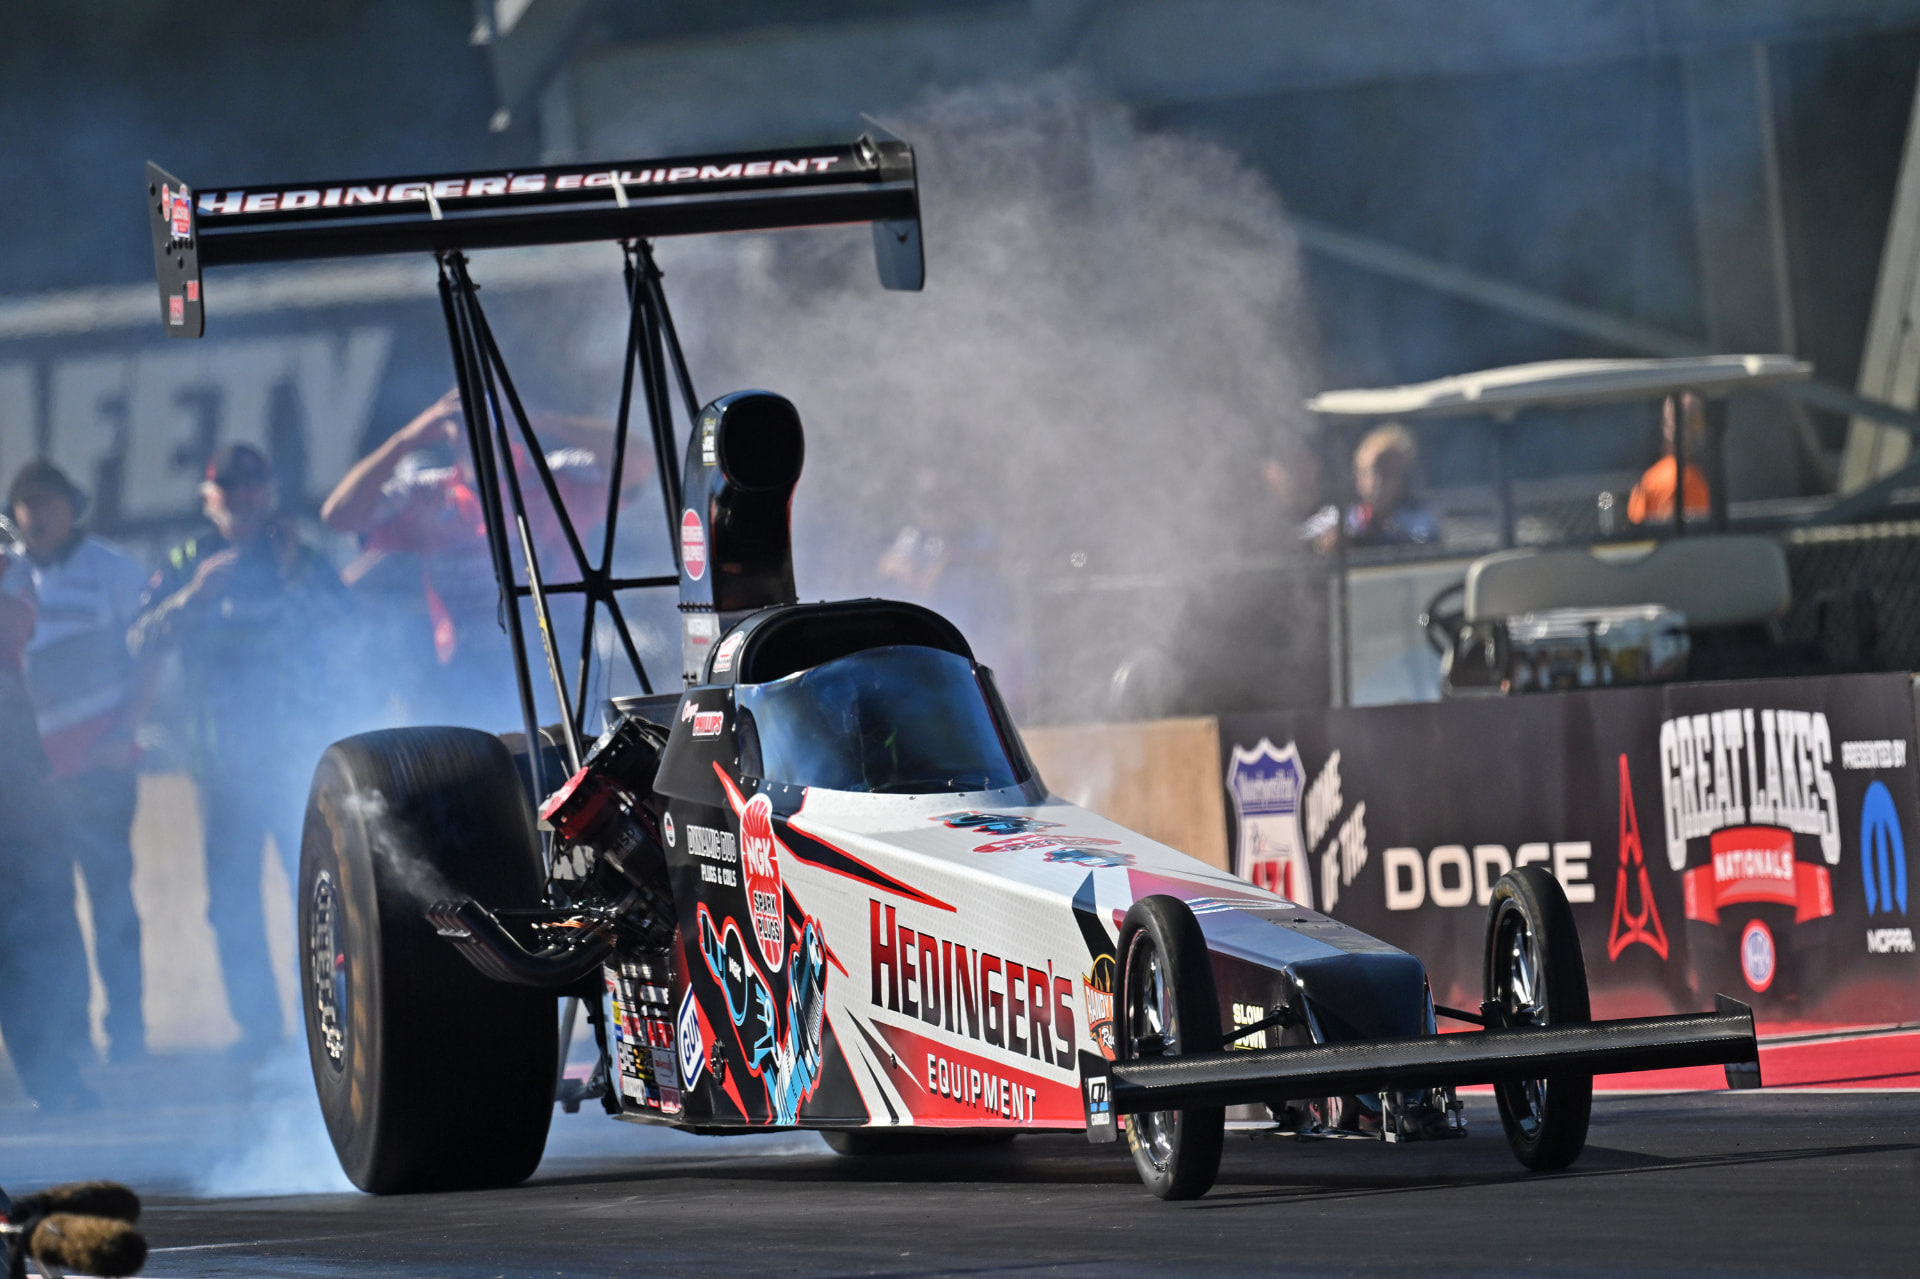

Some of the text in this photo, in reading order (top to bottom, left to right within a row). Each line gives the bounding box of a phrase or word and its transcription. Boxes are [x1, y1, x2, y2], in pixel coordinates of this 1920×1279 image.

[198, 172, 546, 215] HEDINGER'S
[555, 156, 839, 189] EQUIPMENT
[1660, 708, 1841, 870] GREAT LAKES
[686, 824, 721, 860] DYNAMIC
[720, 830, 737, 863] DUO
[745, 835, 774, 878] NGK
[700, 863, 717, 883] PLUGS
[1714, 849, 1793, 884] NATIONALS
[754, 892, 776, 914] SPARK
[757, 916, 780, 941] PLUGS
[869, 898, 1076, 1072] HEDINGER'S
[1232, 1003, 1264, 1024] SLOW
[927, 1053, 1036, 1123] EQUIPMENT
